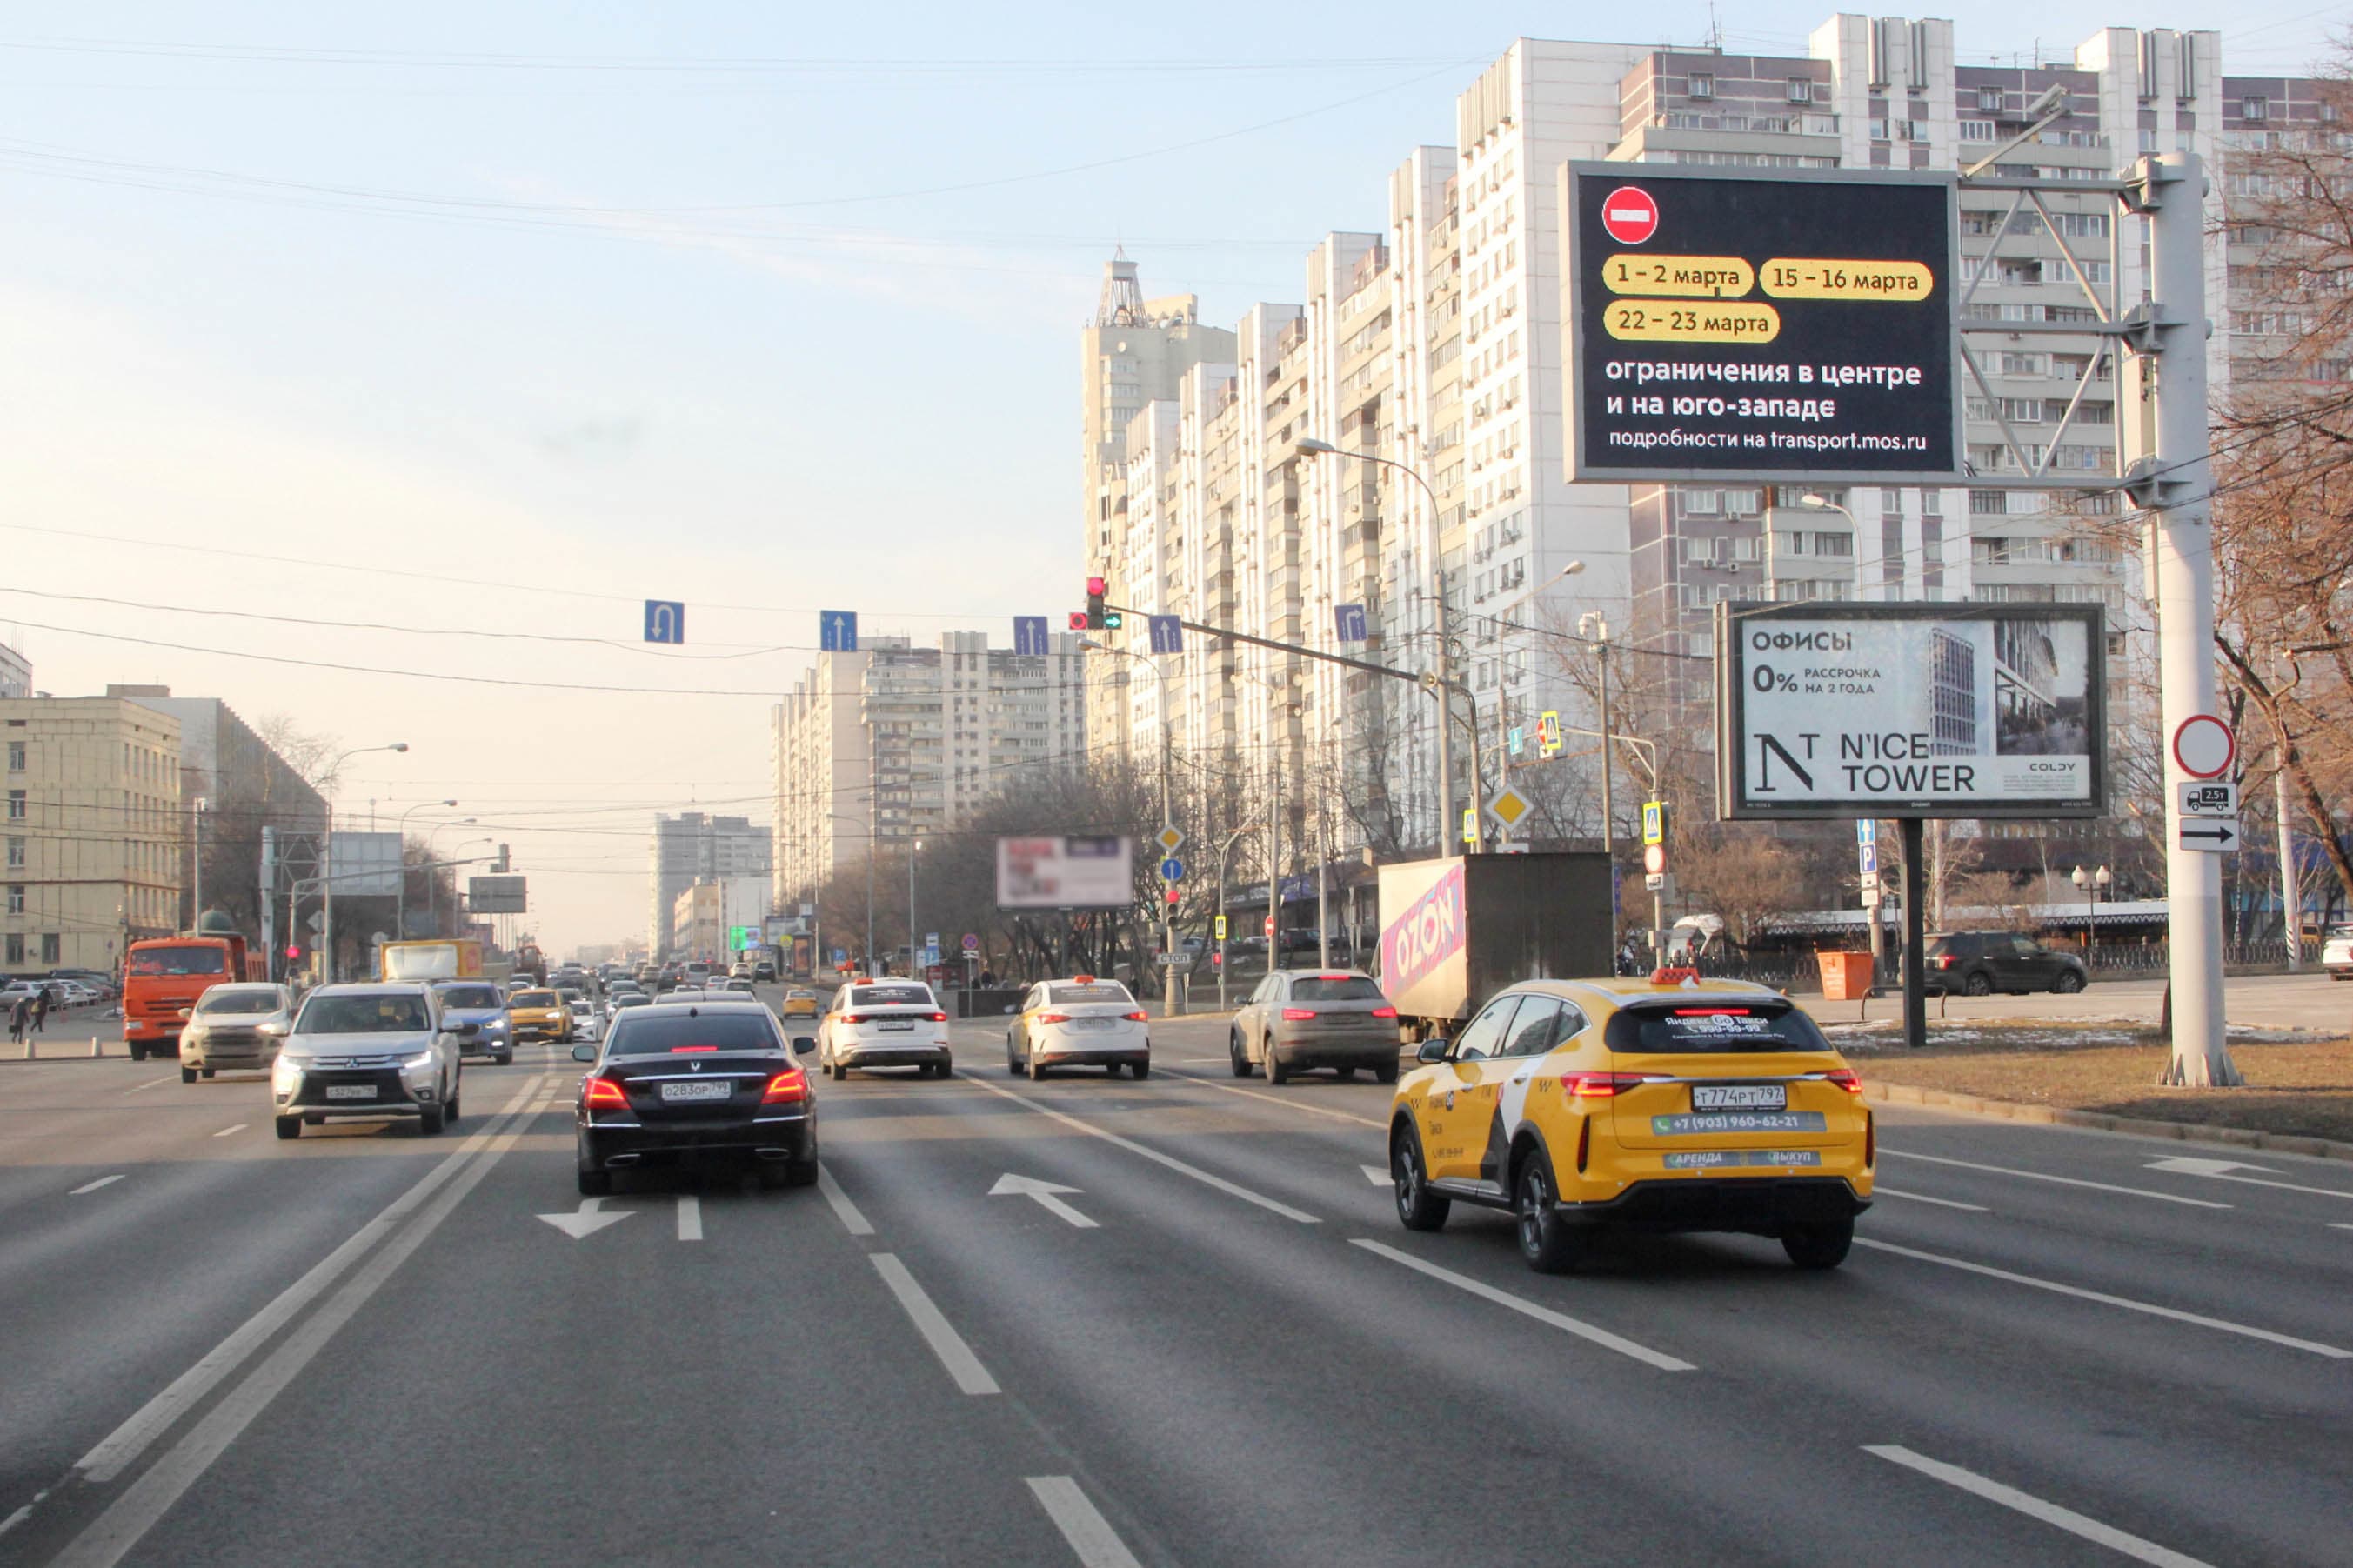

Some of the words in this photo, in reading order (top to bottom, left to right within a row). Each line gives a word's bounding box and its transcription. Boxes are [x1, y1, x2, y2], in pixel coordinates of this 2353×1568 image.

[1675, 270, 1739, 288] марта
[1854, 275, 1918, 293] марта
[1704, 317, 1768, 336] марта
[1606, 362, 1789, 384] ограничения
[1799, 366, 1813, 382] в
[1822, 366, 1921, 390] центре
[1608, 397, 1622, 413] и
[1633, 397, 1663, 414] на
[1673, 397, 1835, 421] юго-западе
[1610, 429, 1737, 449] подробности
[1744, 435, 1765, 448] на
[1770, 432, 1926, 451] transport.mos.ru
[1753, 631, 1851, 651] ОФИСЫ
[1753, 664, 1798, 692] 0%
[1805, 668, 1881, 678] РАССРОЧКА
[1806, 684, 1822, 693] НА
[1828, 684, 1835, 693] 2
[1840, 684, 1874, 694] ГОДА
[1842, 765, 1974, 791] TOWER
[1396, 886, 1454, 978] OZON
[1674, 1118, 1688, 1129] +7
[1693, 1116, 1727, 1130] (903)
[1730, 1116, 1799, 1128] 960-62-21
[1676, 1153, 1722, 1163] АРЕНДА
[1773, 1151, 1811, 1162] ВЫКУП
